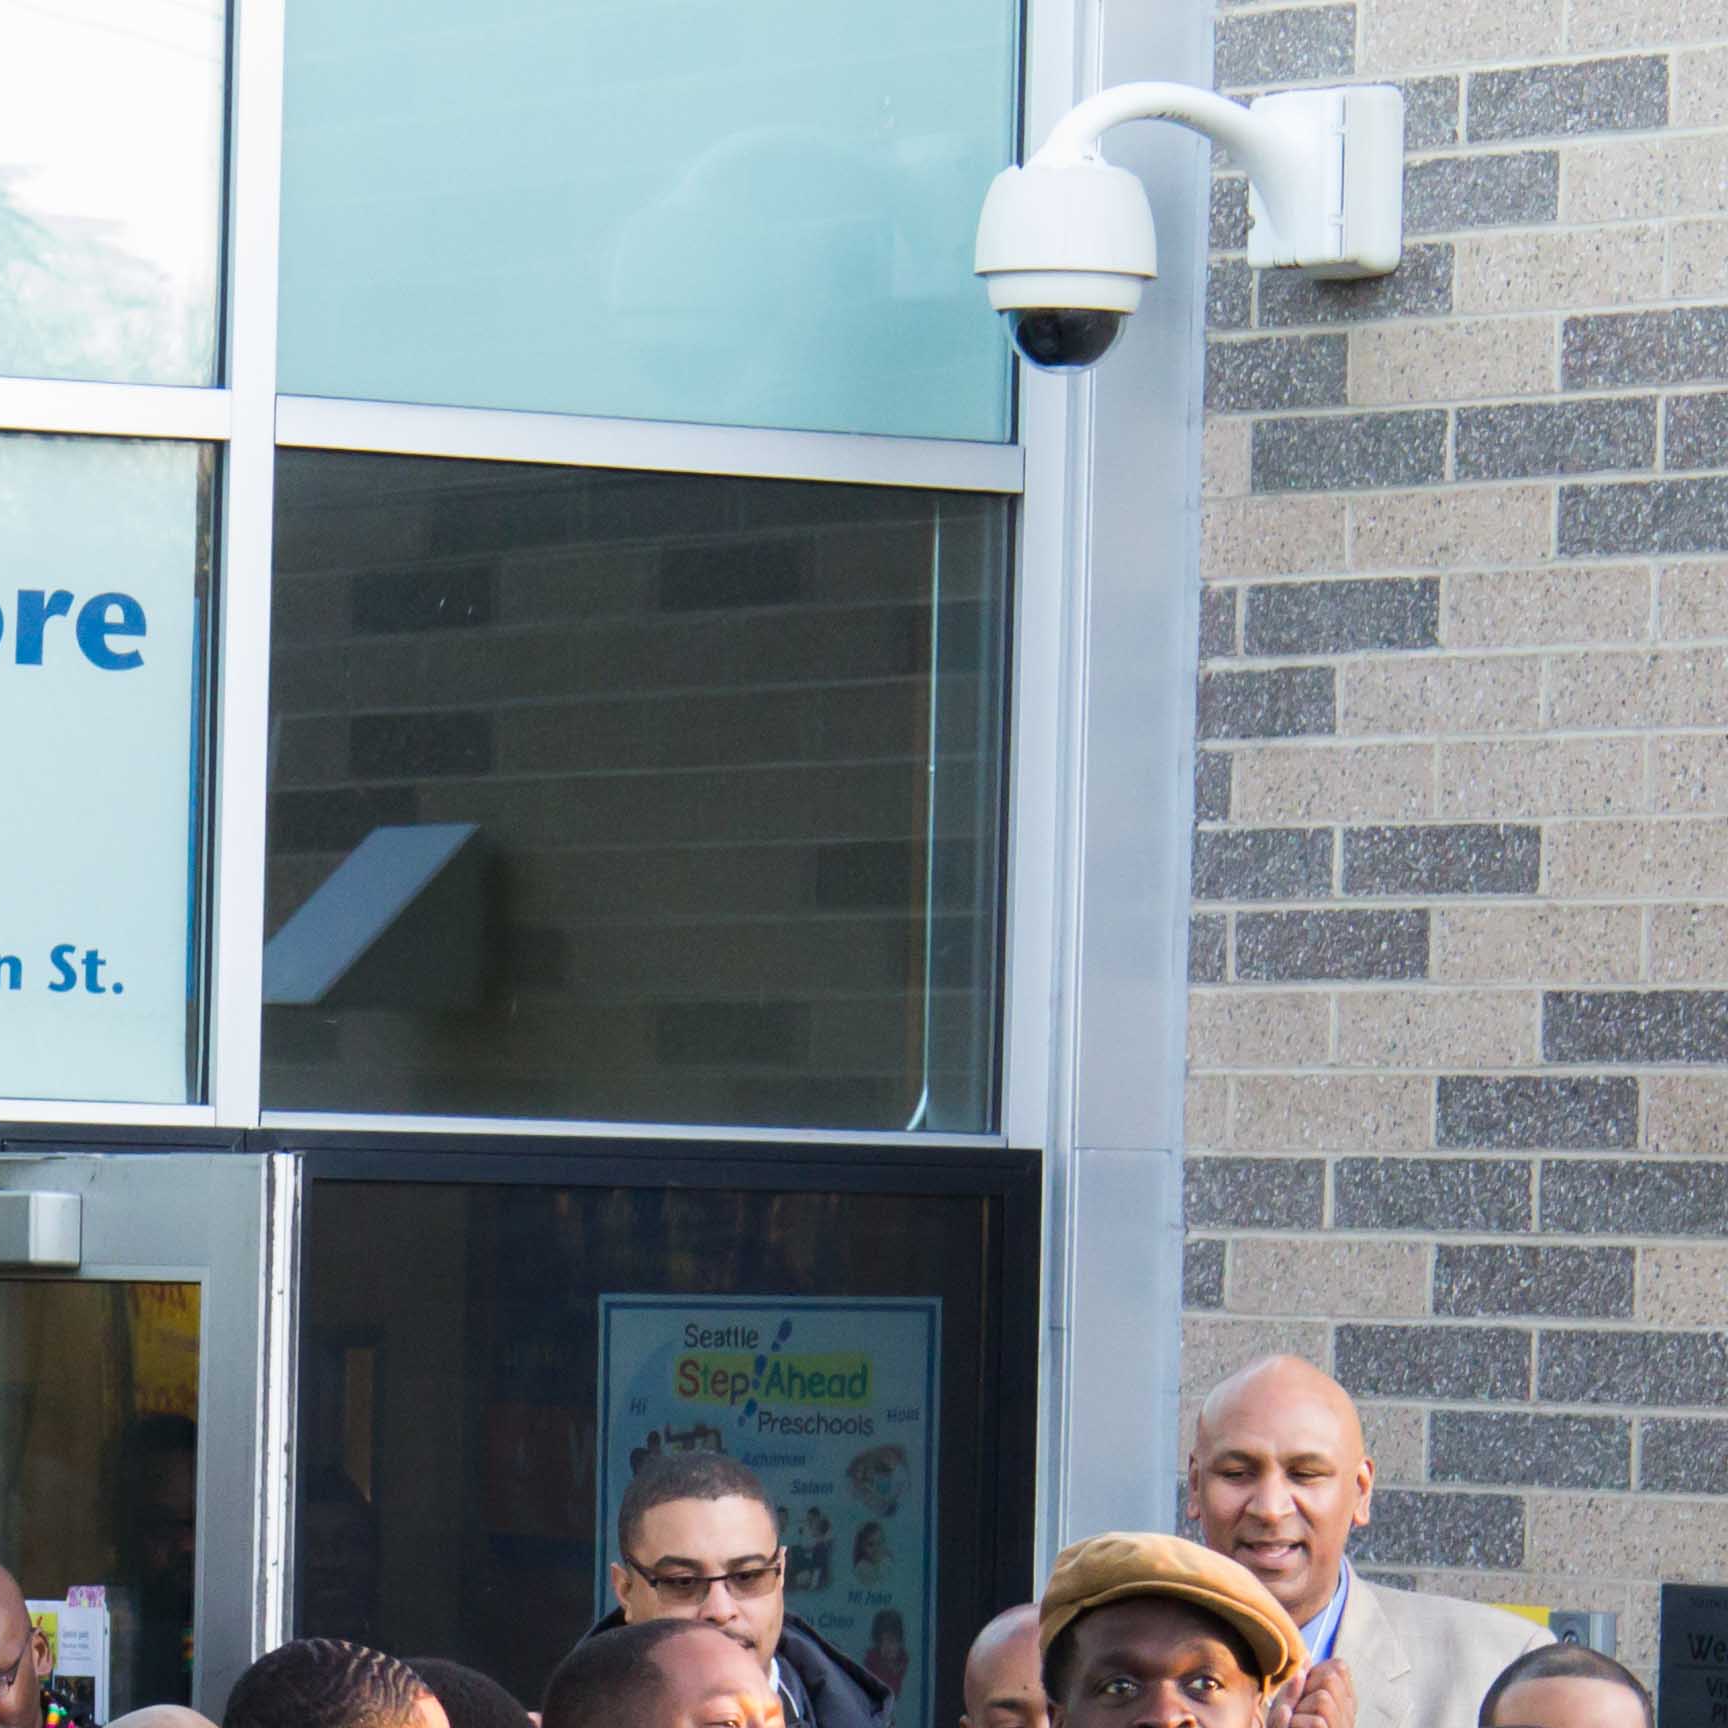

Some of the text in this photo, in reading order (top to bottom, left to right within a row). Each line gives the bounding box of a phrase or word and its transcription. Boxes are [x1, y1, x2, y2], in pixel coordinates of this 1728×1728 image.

[48, 944, 124, 995] St.
[684, 1323, 759, 1348] Seattle
[678, 1360, 867, 1405] Step Ahead
[758, 1411, 874, 1435] Preschools
